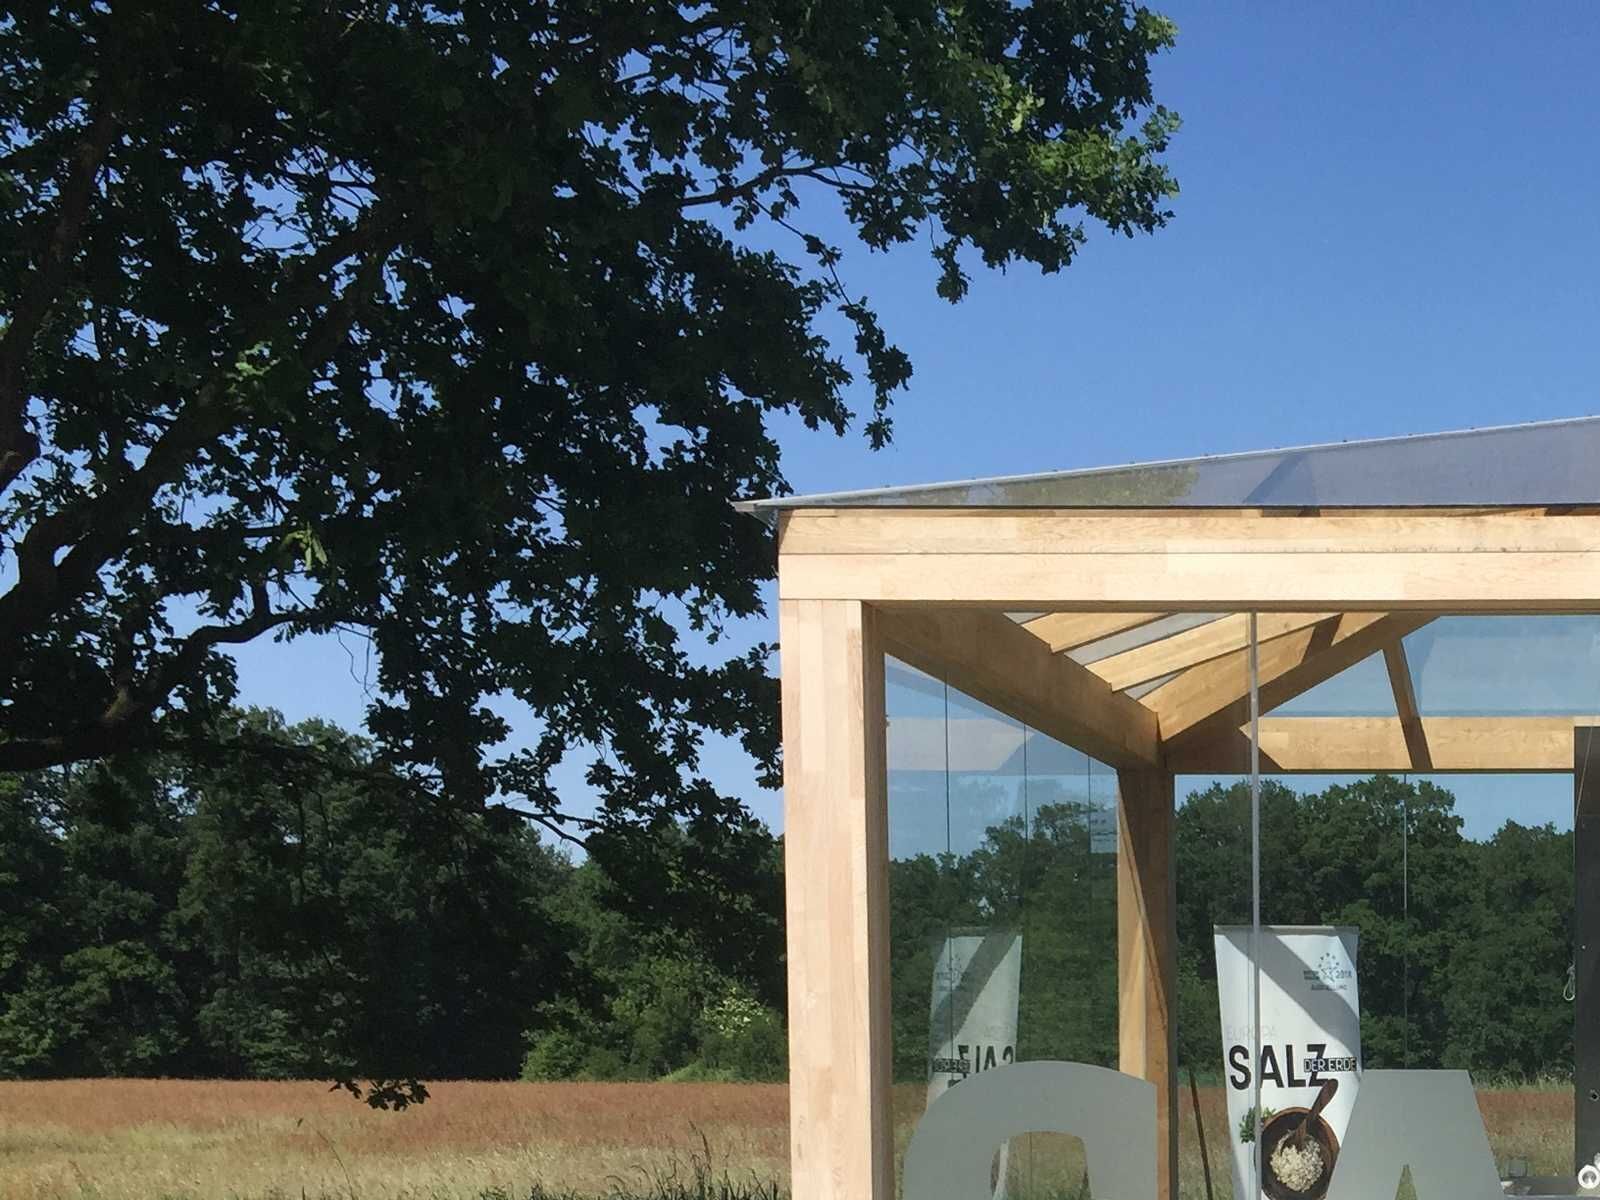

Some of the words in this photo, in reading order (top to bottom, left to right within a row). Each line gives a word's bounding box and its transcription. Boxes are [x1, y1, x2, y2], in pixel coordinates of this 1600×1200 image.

[1229, 1043, 1327, 1090] SALZ
[1304, 1059, 1325, 1071] DER
[1328, 1058, 1356, 1071] ERDE
